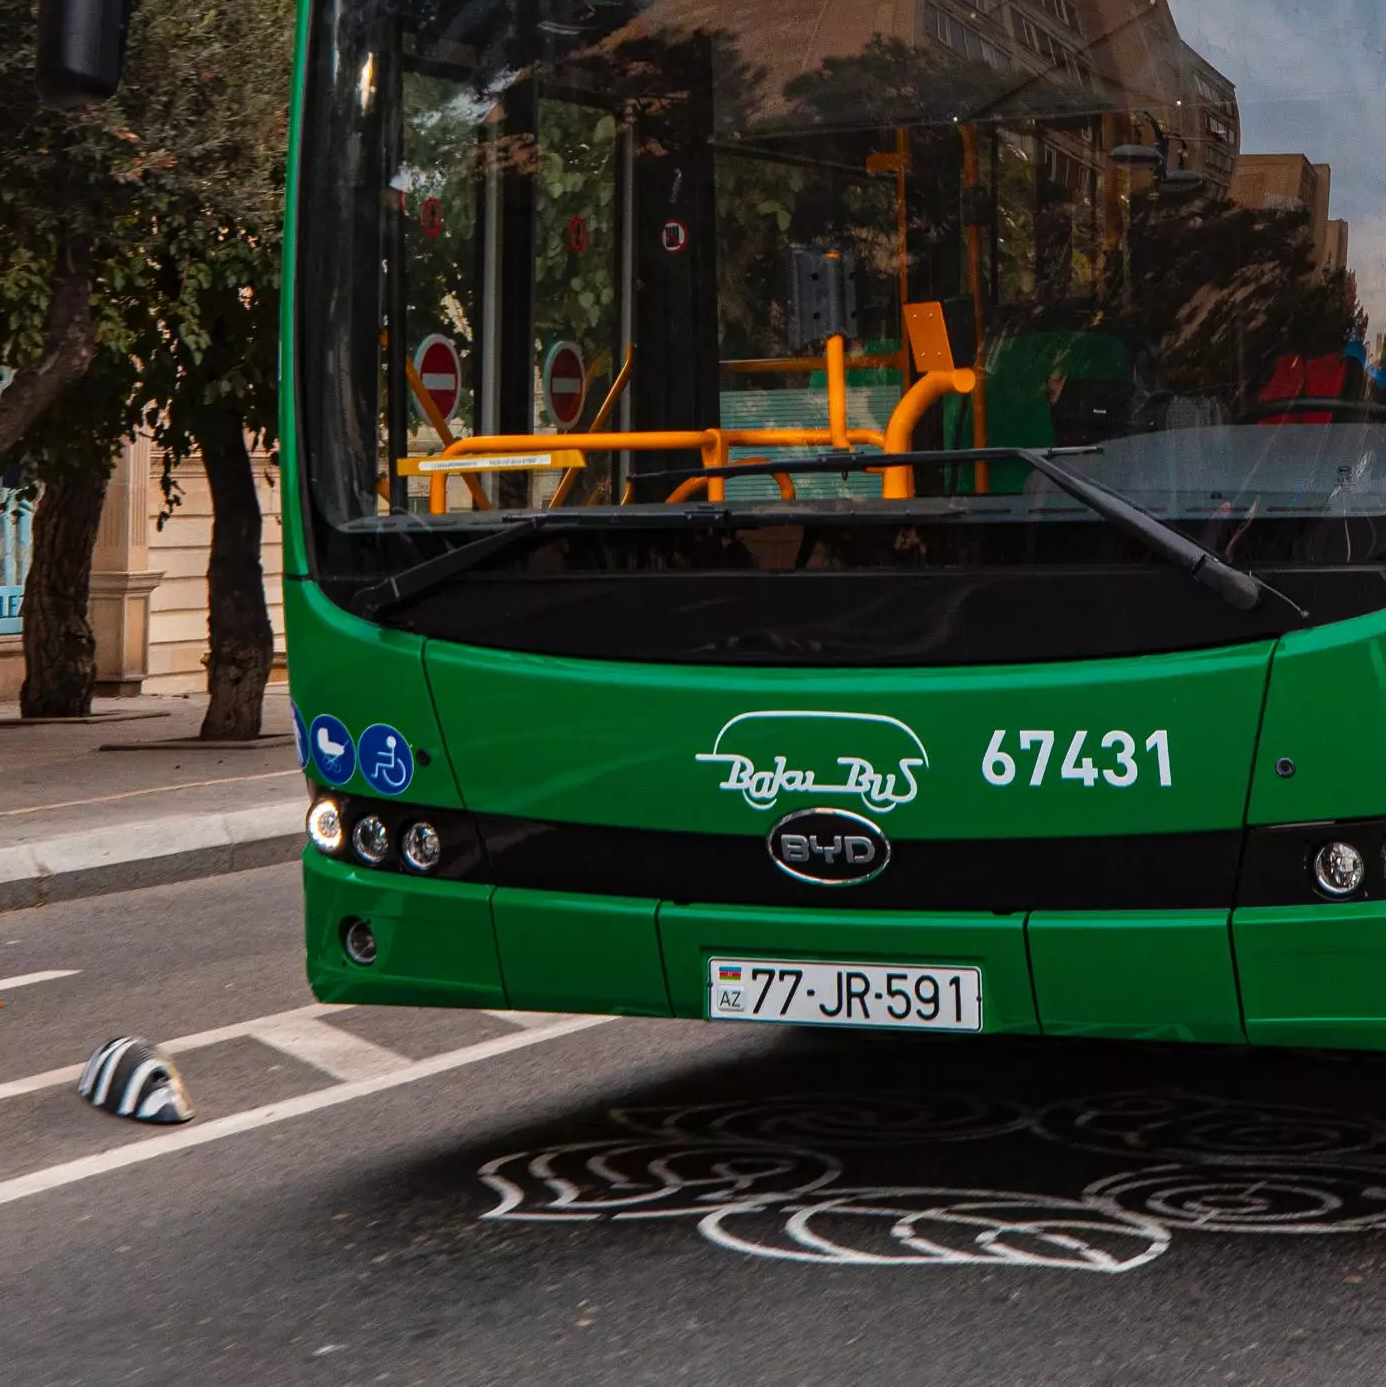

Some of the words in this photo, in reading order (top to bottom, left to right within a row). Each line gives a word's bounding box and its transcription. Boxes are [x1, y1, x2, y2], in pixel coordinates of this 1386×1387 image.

[981, 729, 1172, 787] 67431
[781, 834, 876, 864] BYD
[719, 990, 742, 1008] AZ
